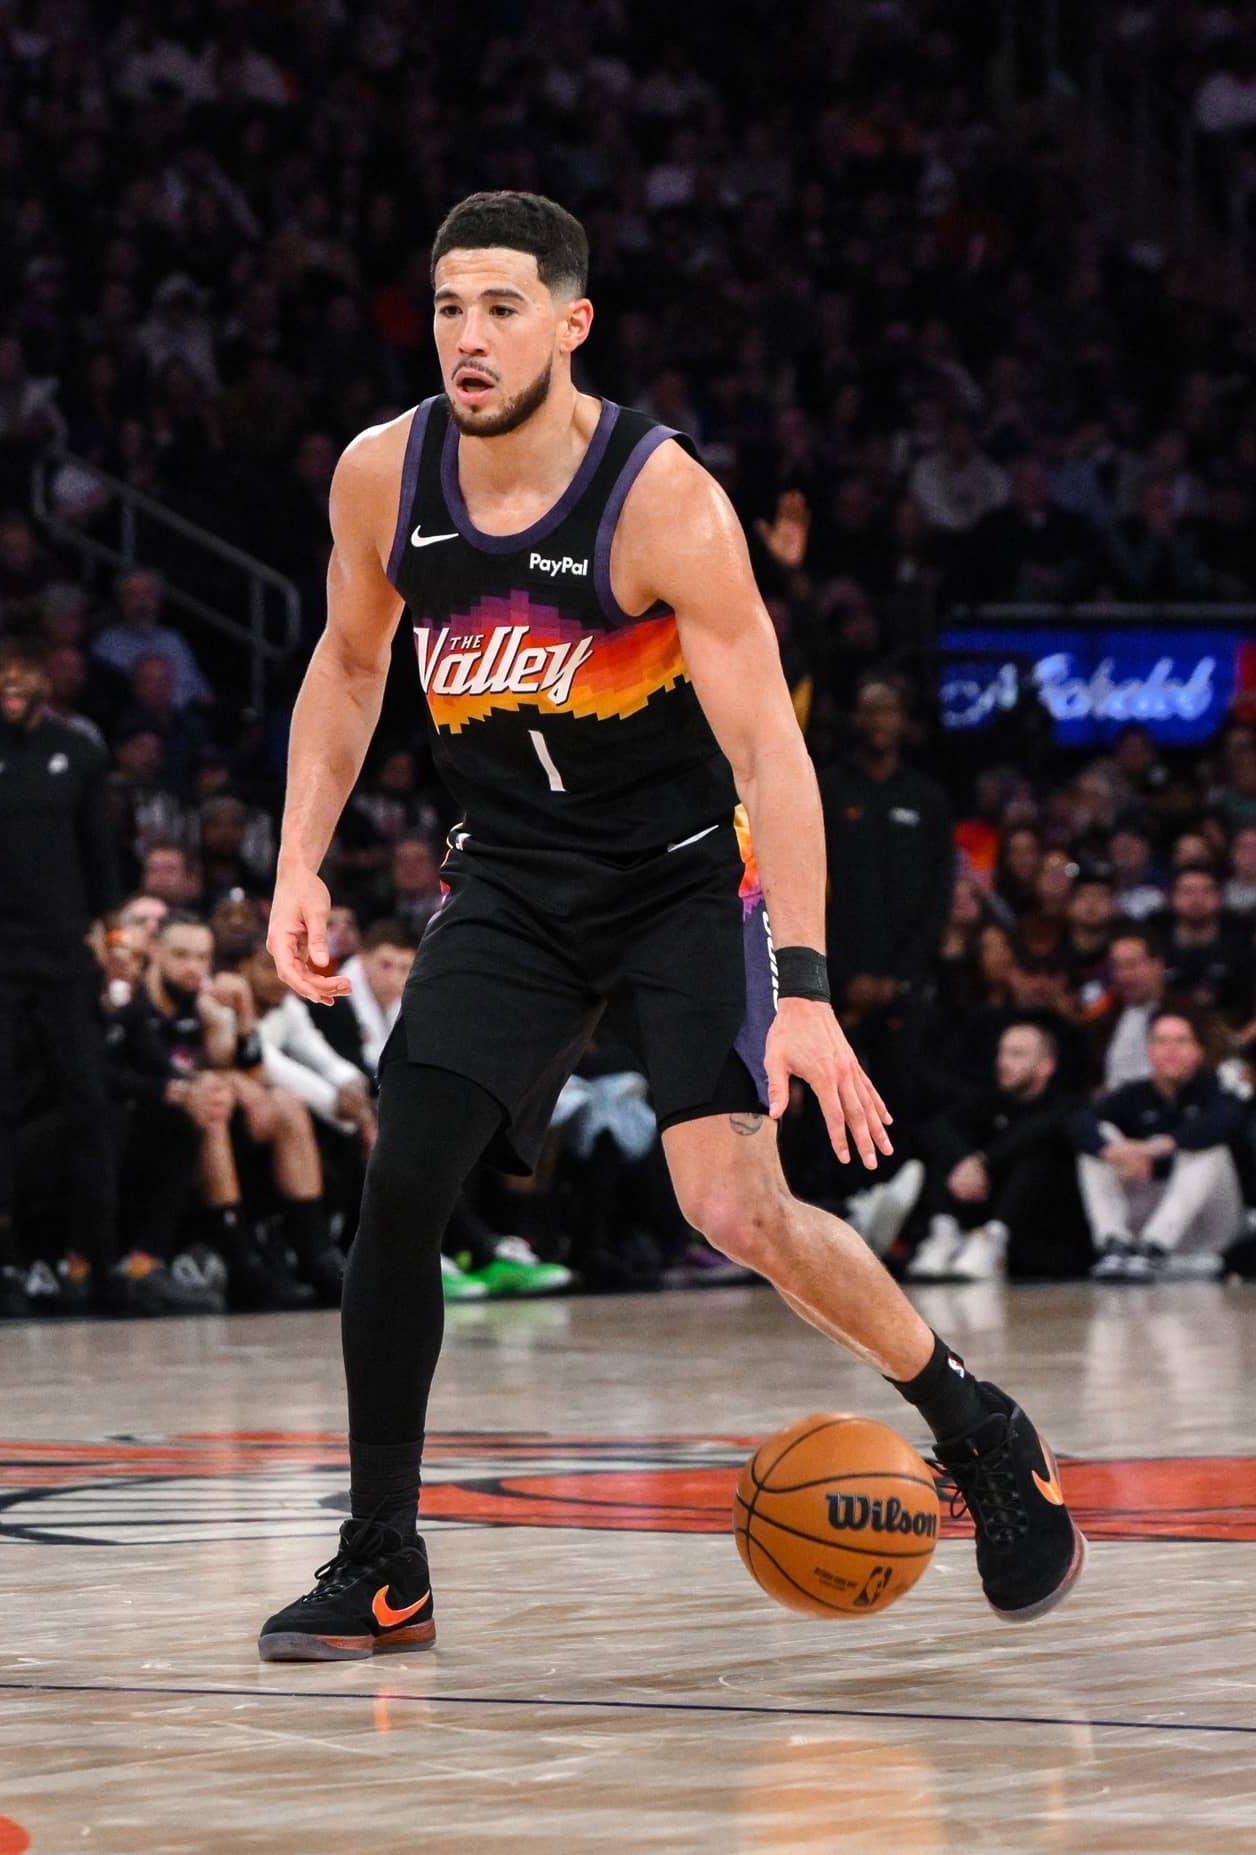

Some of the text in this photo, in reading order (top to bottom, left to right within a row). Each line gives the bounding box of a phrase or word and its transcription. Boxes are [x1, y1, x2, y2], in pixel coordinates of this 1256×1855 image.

[529, 552, 589, 577] PayPal
[449, 633, 485, 651] THE
[412, 624, 594, 707] Valley
[527, 729, 566, 792] 1
[826, 1493, 937, 1537] Wilson
